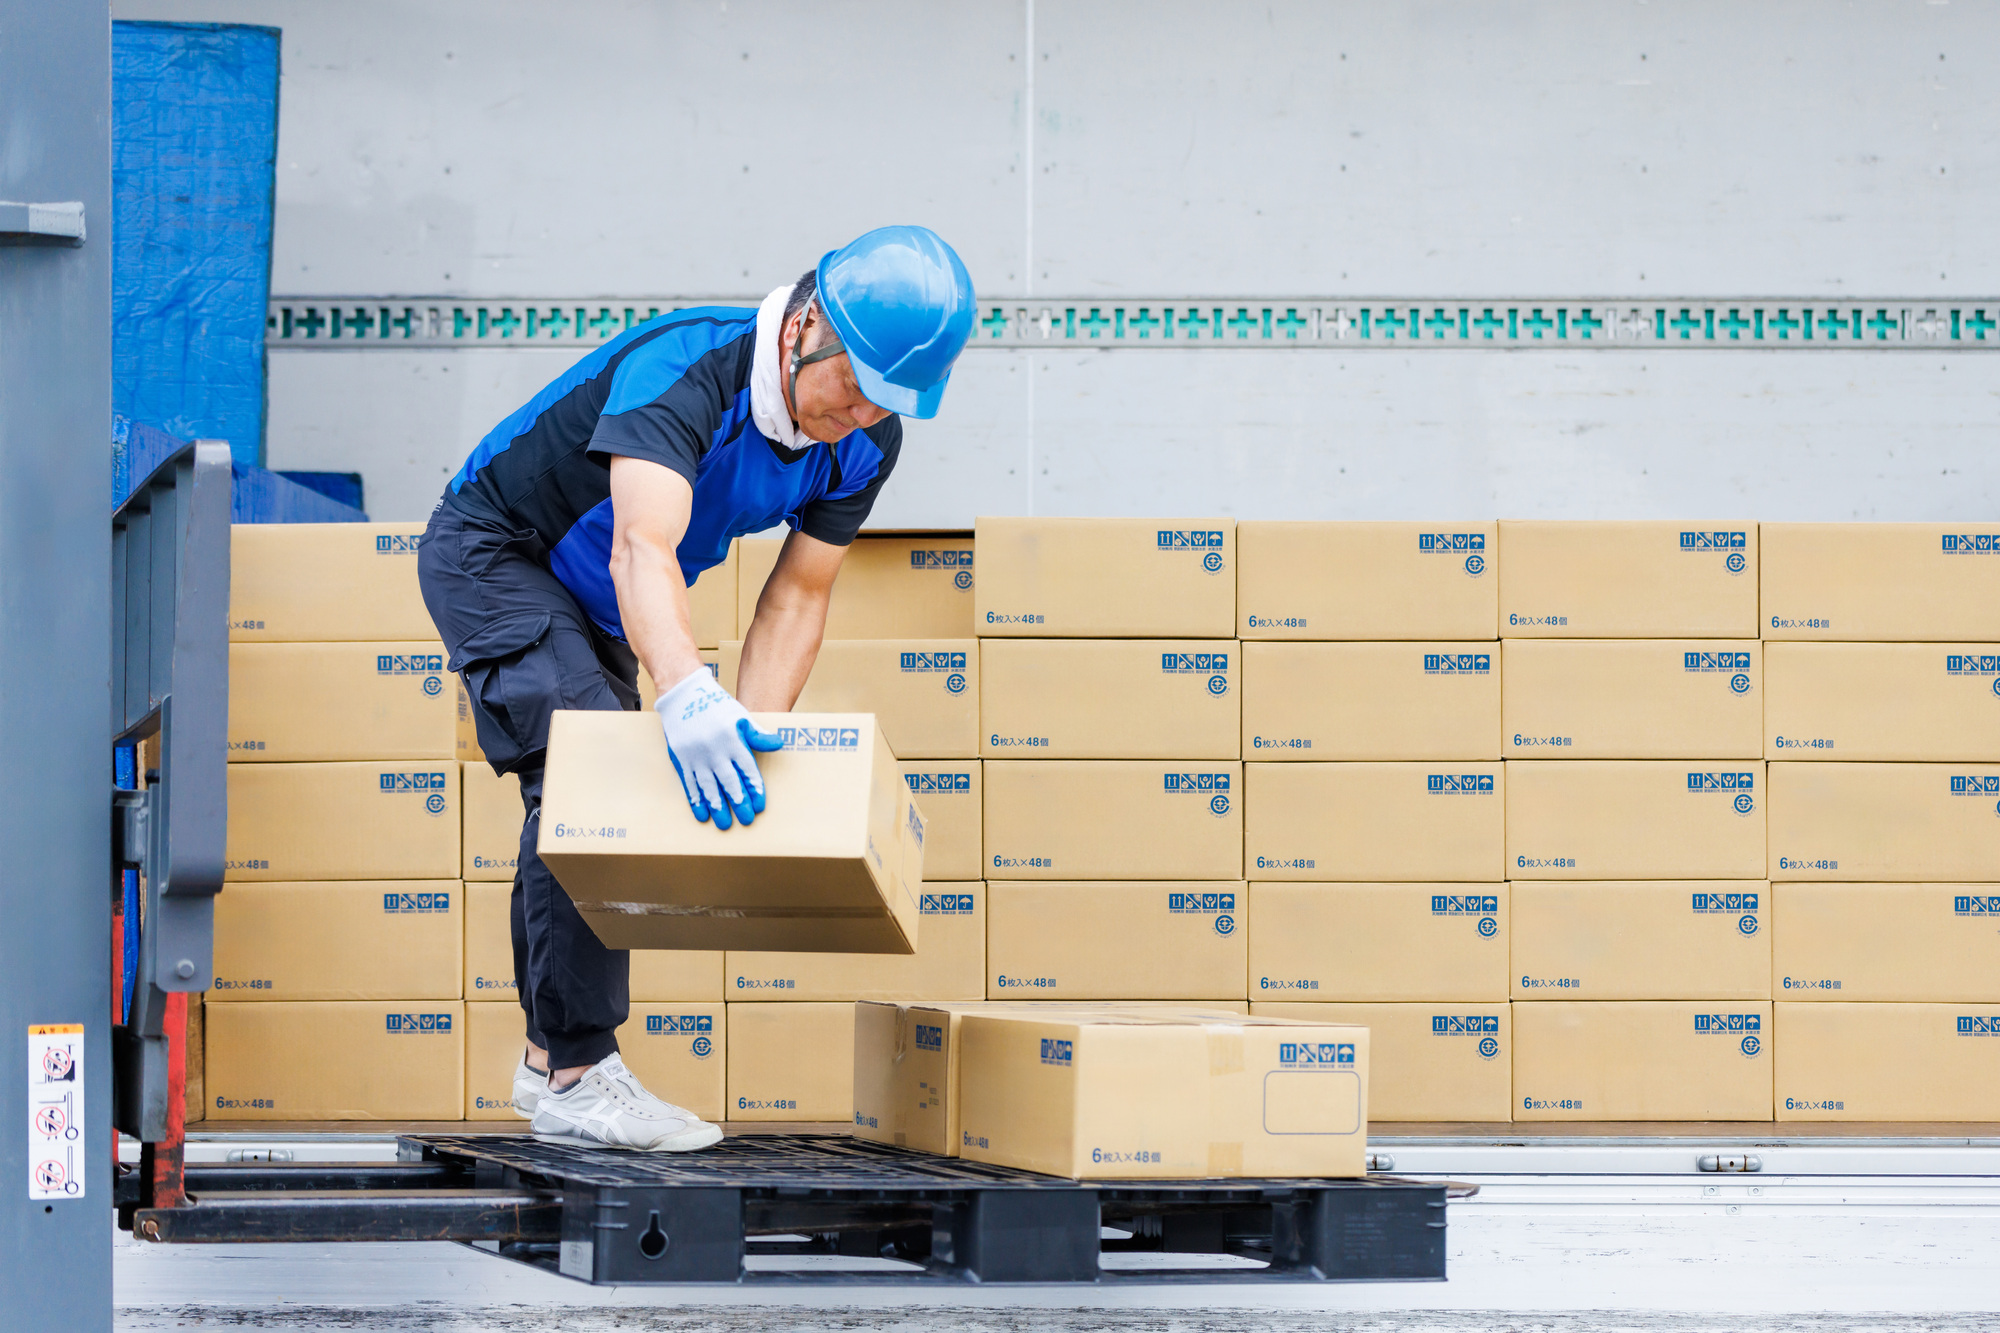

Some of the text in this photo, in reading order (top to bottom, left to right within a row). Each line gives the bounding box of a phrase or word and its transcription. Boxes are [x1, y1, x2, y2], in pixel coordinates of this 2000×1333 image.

[986, 611, 1045, 624] 6枚入×48個
[1249, 615, 1307, 628] 6枚入×48個
[1509, 613, 1568, 627] 6枚入×48個
[1771, 616, 1829, 629] 6枚入×48個
[991, 734, 1049, 747] 6枚入×48個
[1253, 736, 1312, 749] 6枚入×48個
[1514, 734, 1572, 747] 6枚入×48個
[1776, 736, 1834, 749] 6枚入×48個
[555, 824, 627, 838] 6枚入×48個
[994, 855, 1052, 868] 6枚入×48個
[1257, 856, 1315, 869] 6枚入×48個
[1517, 856, 1575, 869] 6枚入×48個
[1780, 857, 1838, 870] 6枚入×48個
[215, 977, 272, 990] 6枚入×48個
[737, 976, 795, 989] 6枚入×48個
[998, 975, 1056, 988] 6枚入×48個
[1260, 977, 1318, 990] 6枚入×48個
[1522, 976, 1580, 989] 6枚入×48個
[1783, 977, 1842, 990] 6枚入×48個
[216, 1096, 275, 1109] 6枚入×48個
[738, 1097, 796, 1110] 6枚入×48個
[1524, 1097, 1583, 1110] 6枚入×48個
[1786, 1097, 1844, 1110] 6枚入×48個
[1092, 1148, 1161, 1164] 6枚入×48個
